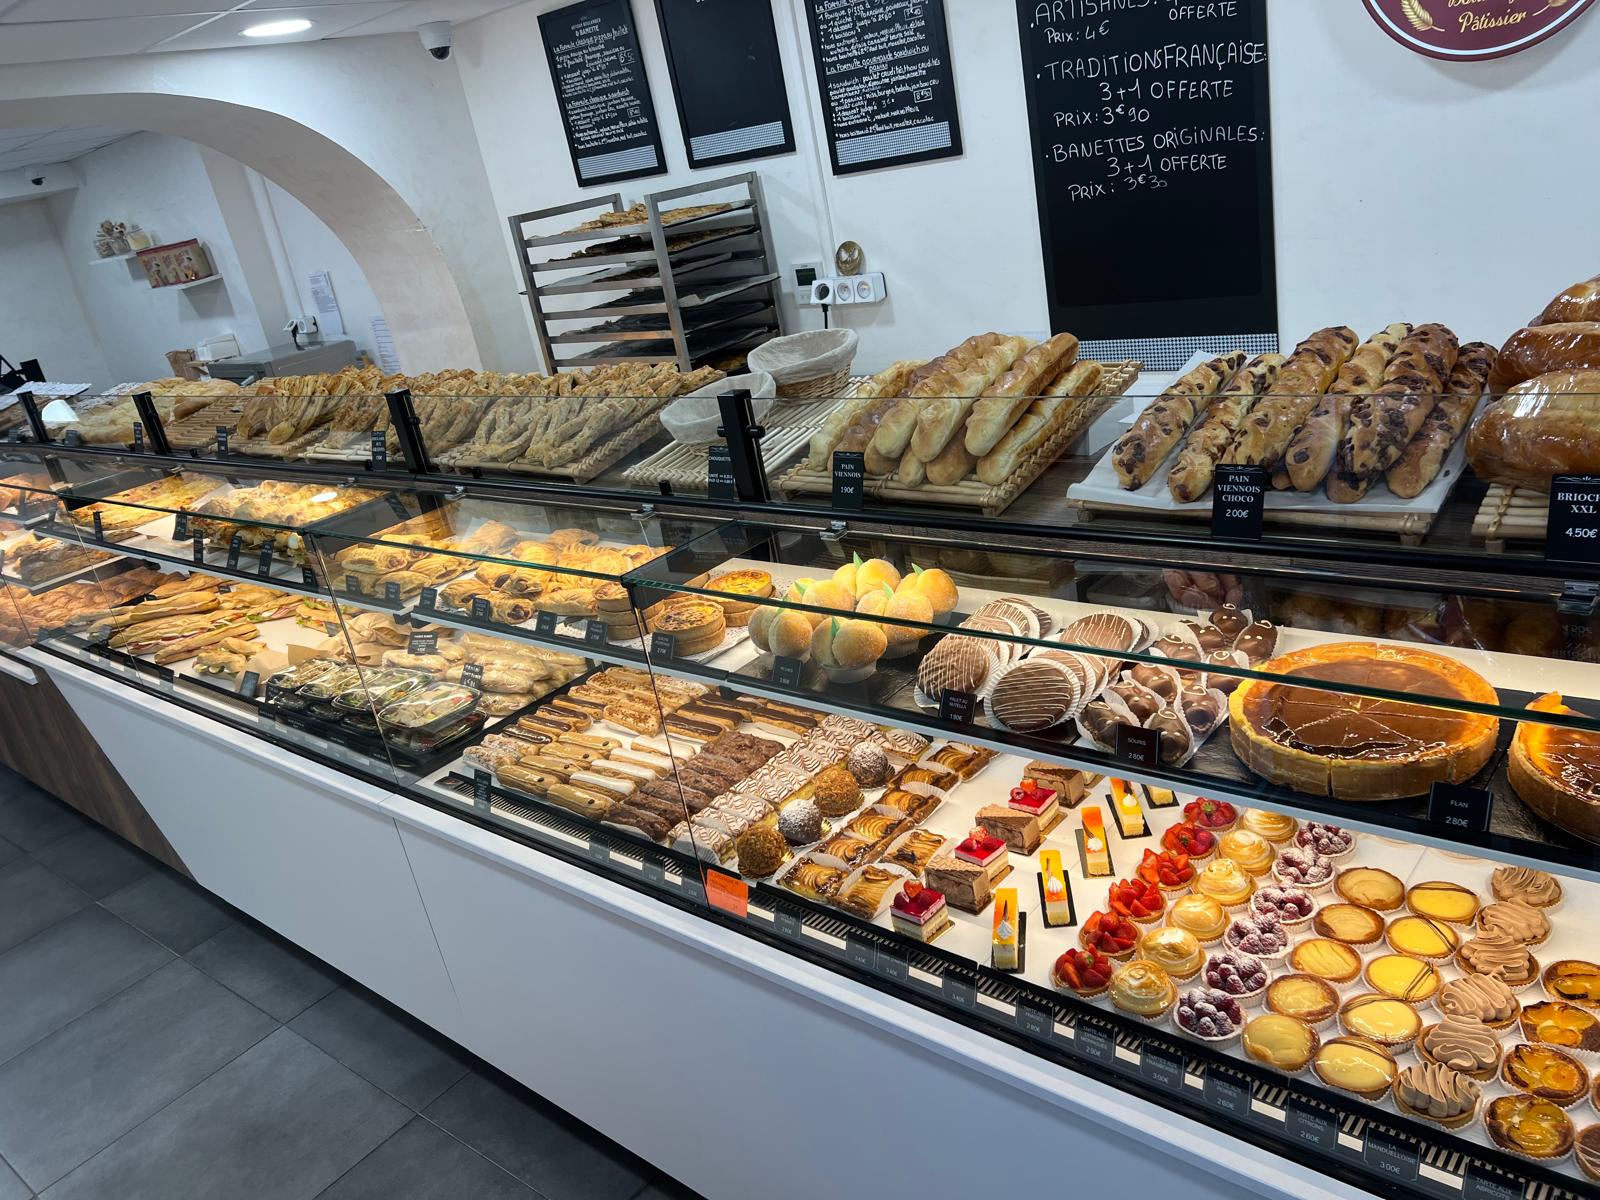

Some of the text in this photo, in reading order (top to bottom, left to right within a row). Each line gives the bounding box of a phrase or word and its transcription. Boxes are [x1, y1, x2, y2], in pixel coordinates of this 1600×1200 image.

[1169, 1, 1238, 21] OFFERTE
[1458, 9, 1527, 33] Pâtissier
[1085, 19, 1110, 40] 4€
[1150, 79, 1233, 100] OFFERTE
[1053, 125, 1265, 162] BANETTES ORIGINALES:
[1160, 153, 1227, 172] OFFERTE
[834, 471, 861, 479] VIENNOIS
[1217, 484, 1260, 494] VIENNOIS
[1222, 494, 1254, 503] CHOCO
[1570, 504, 1597, 514] XXL
[1450, 800, 1468, 808] FLAN
[1296, 1110, 1328, 1126] TARTE AUX
[1297, 1117, 1324, 1132] CITRONS
[1476, 1177, 1513, 1194] TARTE AUX
